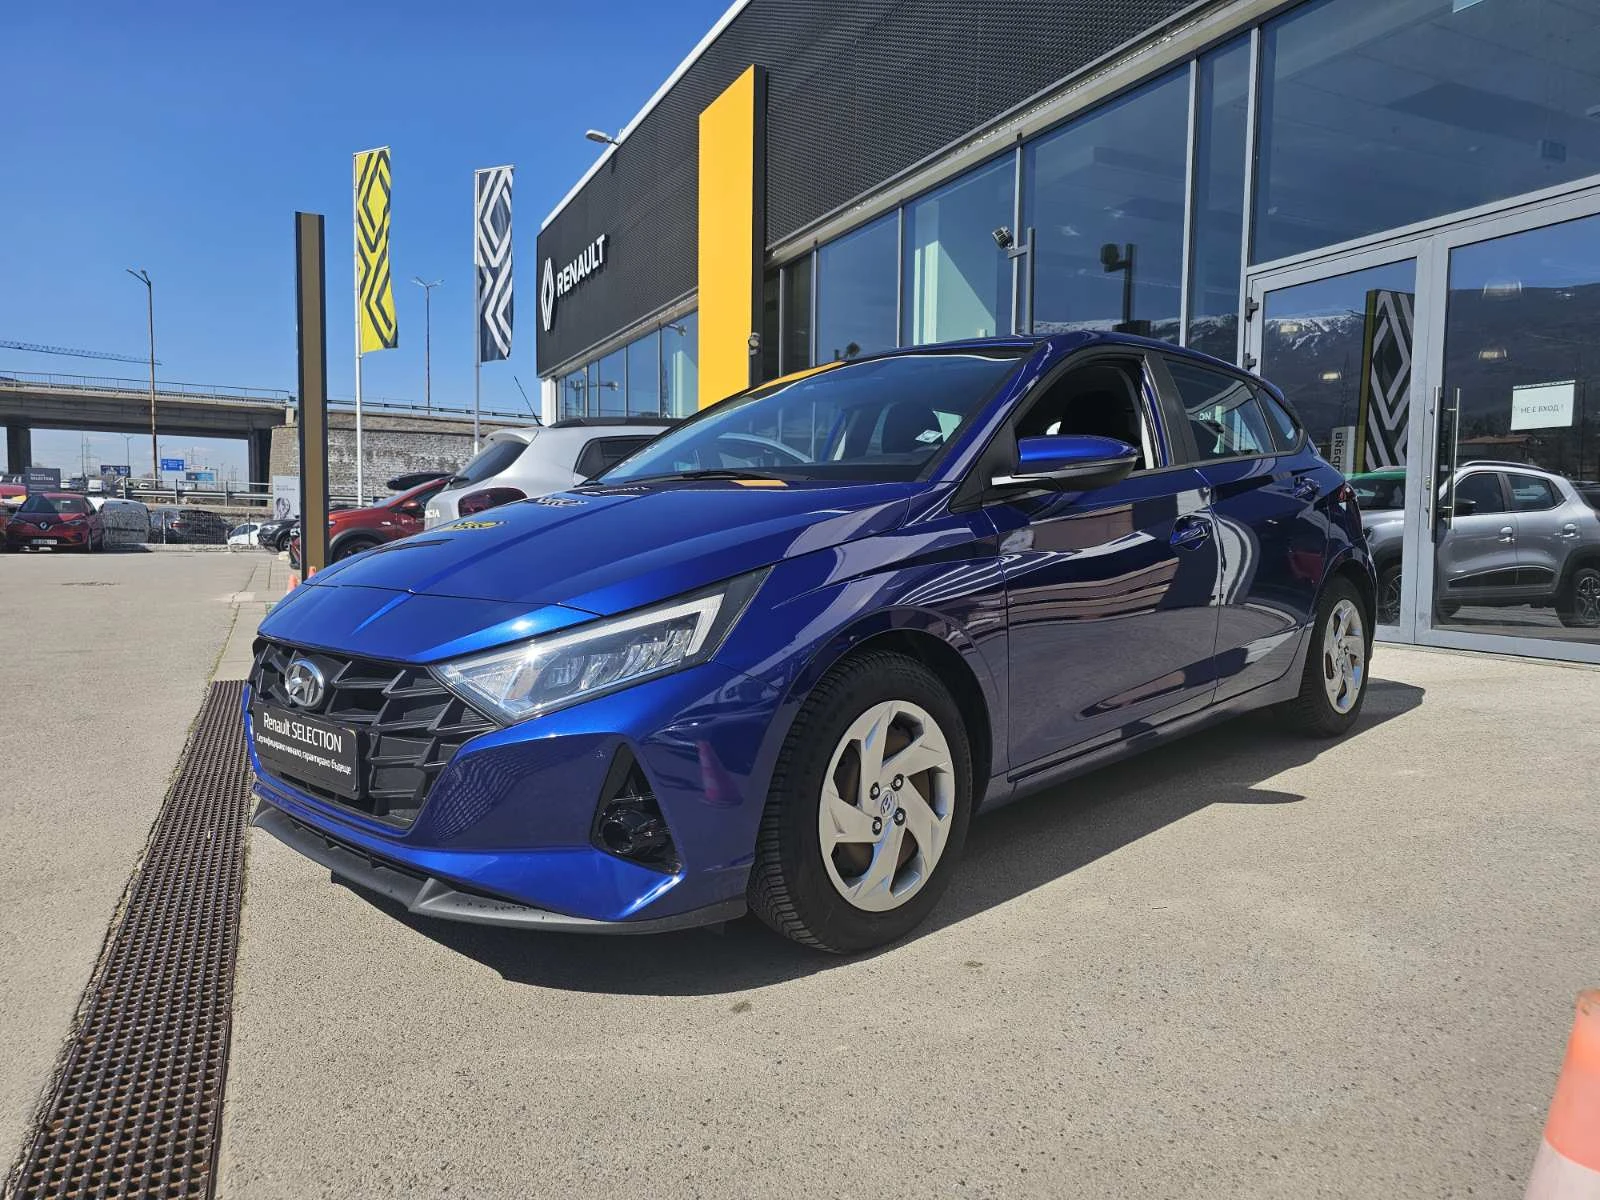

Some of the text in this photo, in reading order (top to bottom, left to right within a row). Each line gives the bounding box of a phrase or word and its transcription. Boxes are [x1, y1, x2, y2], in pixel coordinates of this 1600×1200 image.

[557, 233, 605, 298] RENAULT
[263, 711, 342, 753] Renault SELECTION
